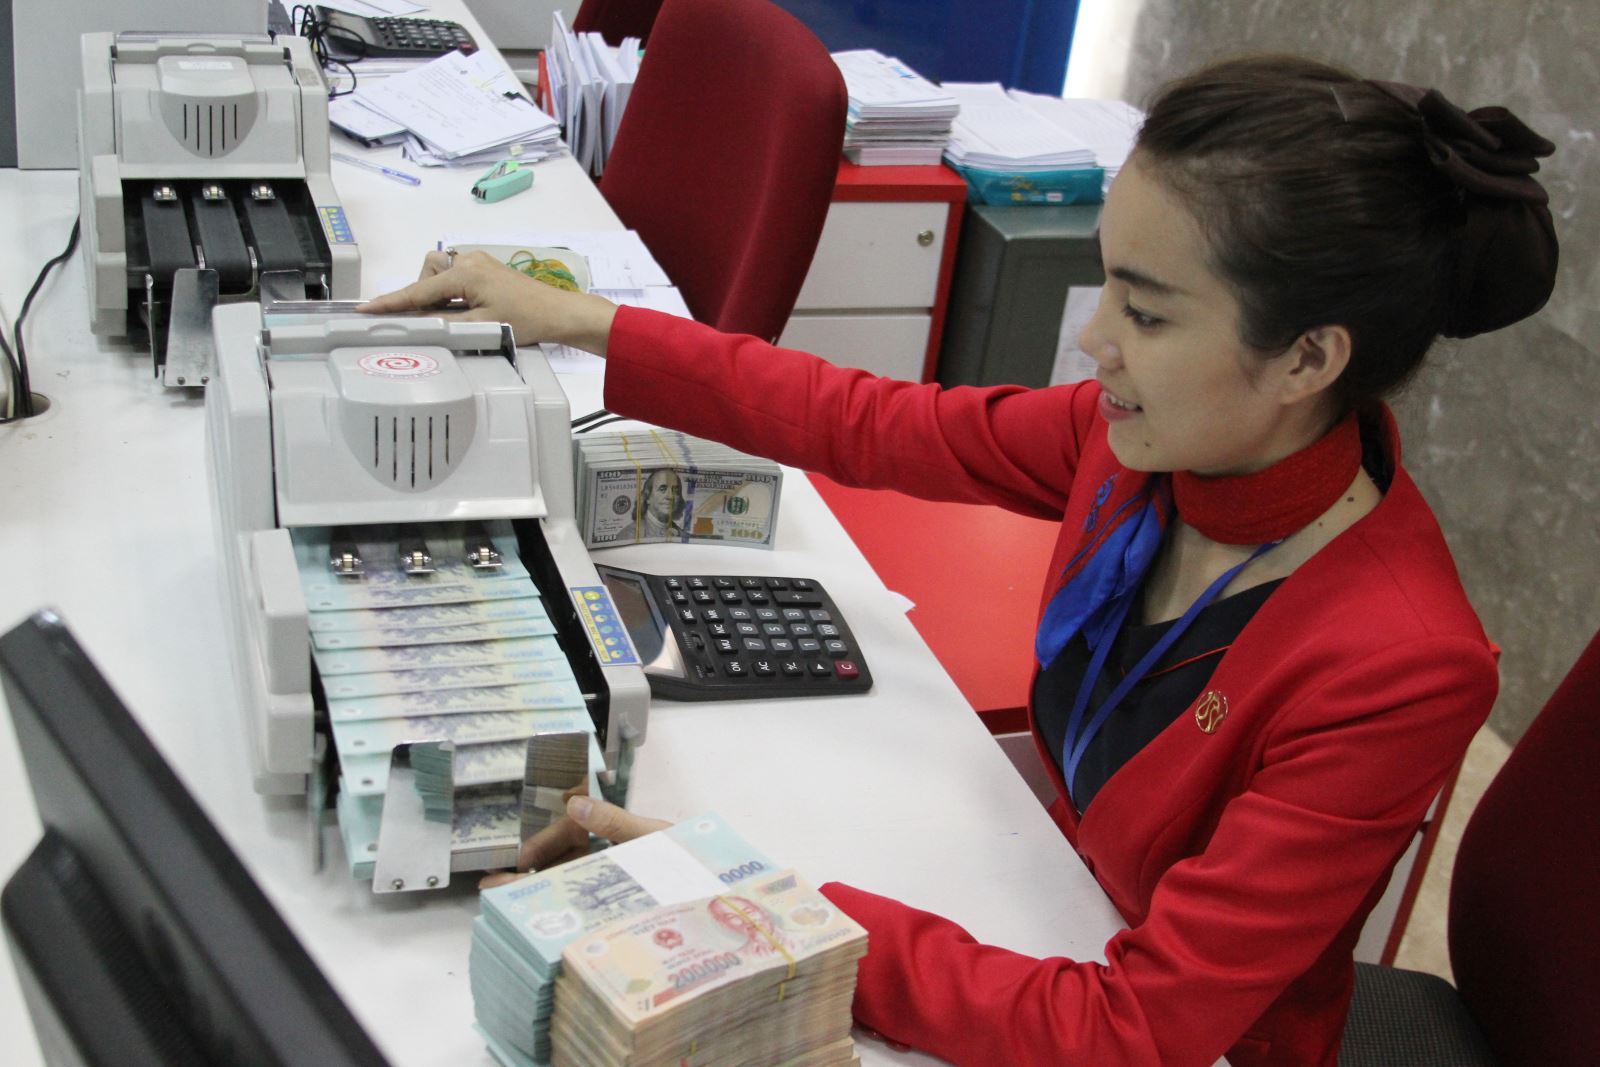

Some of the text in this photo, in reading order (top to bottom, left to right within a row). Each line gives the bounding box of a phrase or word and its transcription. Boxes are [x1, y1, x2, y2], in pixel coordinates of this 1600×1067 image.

[714, 624, 725, 634] MC
[730, 661, 741, 672] ON
[758, 661, 771, 671] AC
[667, 951, 743, 989] 200000
